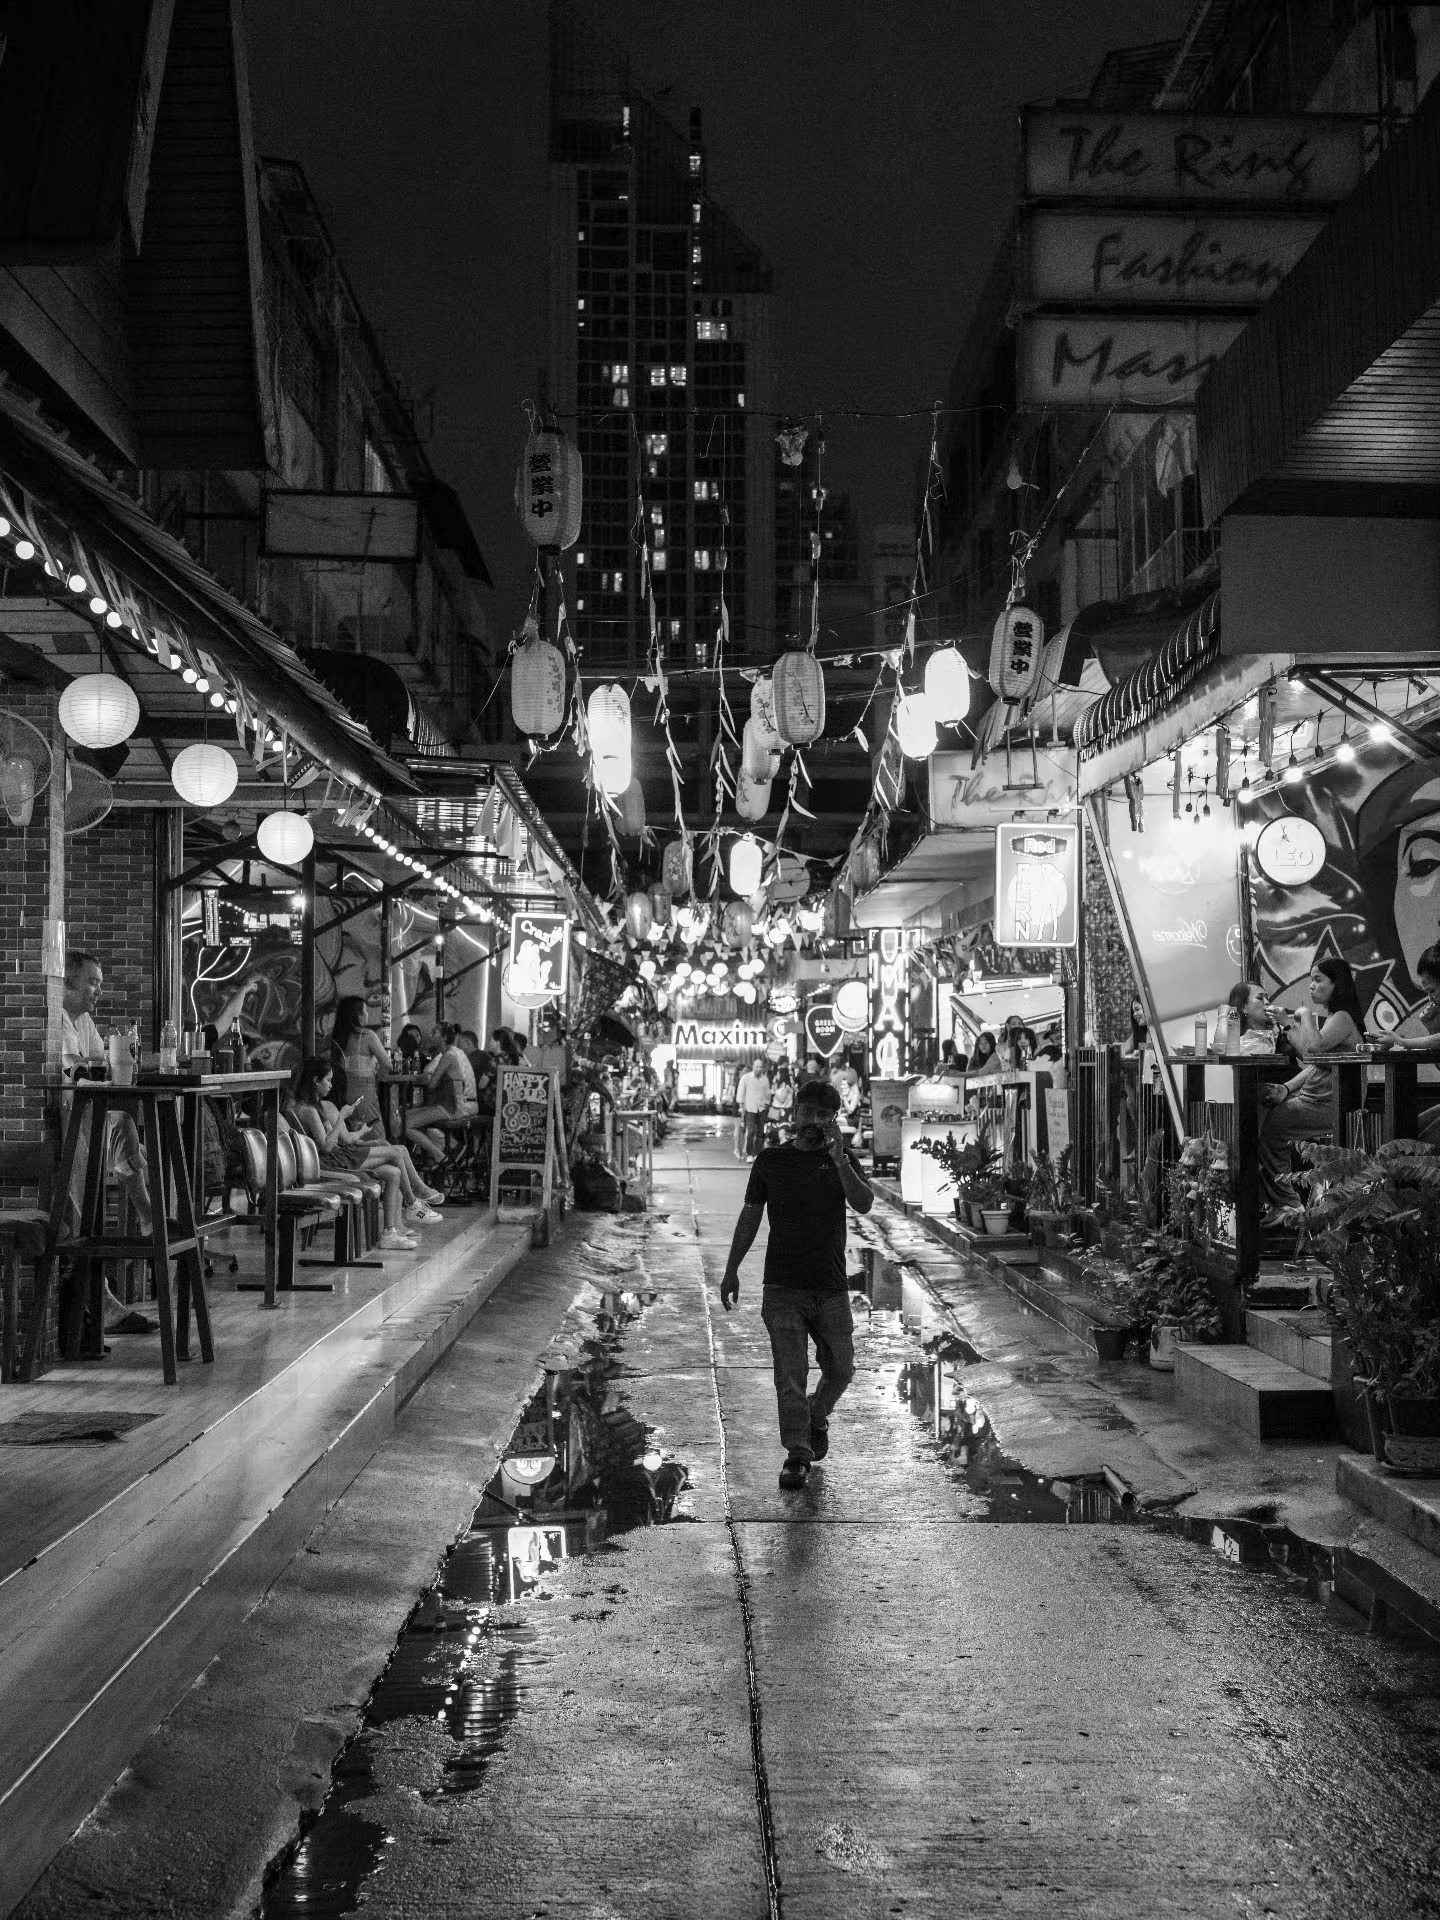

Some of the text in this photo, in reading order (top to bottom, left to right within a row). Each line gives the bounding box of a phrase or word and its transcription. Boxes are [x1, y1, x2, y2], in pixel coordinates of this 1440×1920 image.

[1059, 122, 1316, 193] The Ring
[1091, 230, 1285, 292] Fashion
[949, 771, 1007, 809] The
[1023, 837, 1056, 855] Red
[1271, 847, 1314, 867] LEO
[1015, 862, 1033, 941] FERN
[815, 1026, 836, 1034] ROOM
[503, 1071, 550, 1090] HAPPY
[507, 1086, 549, 1104] HOUR
